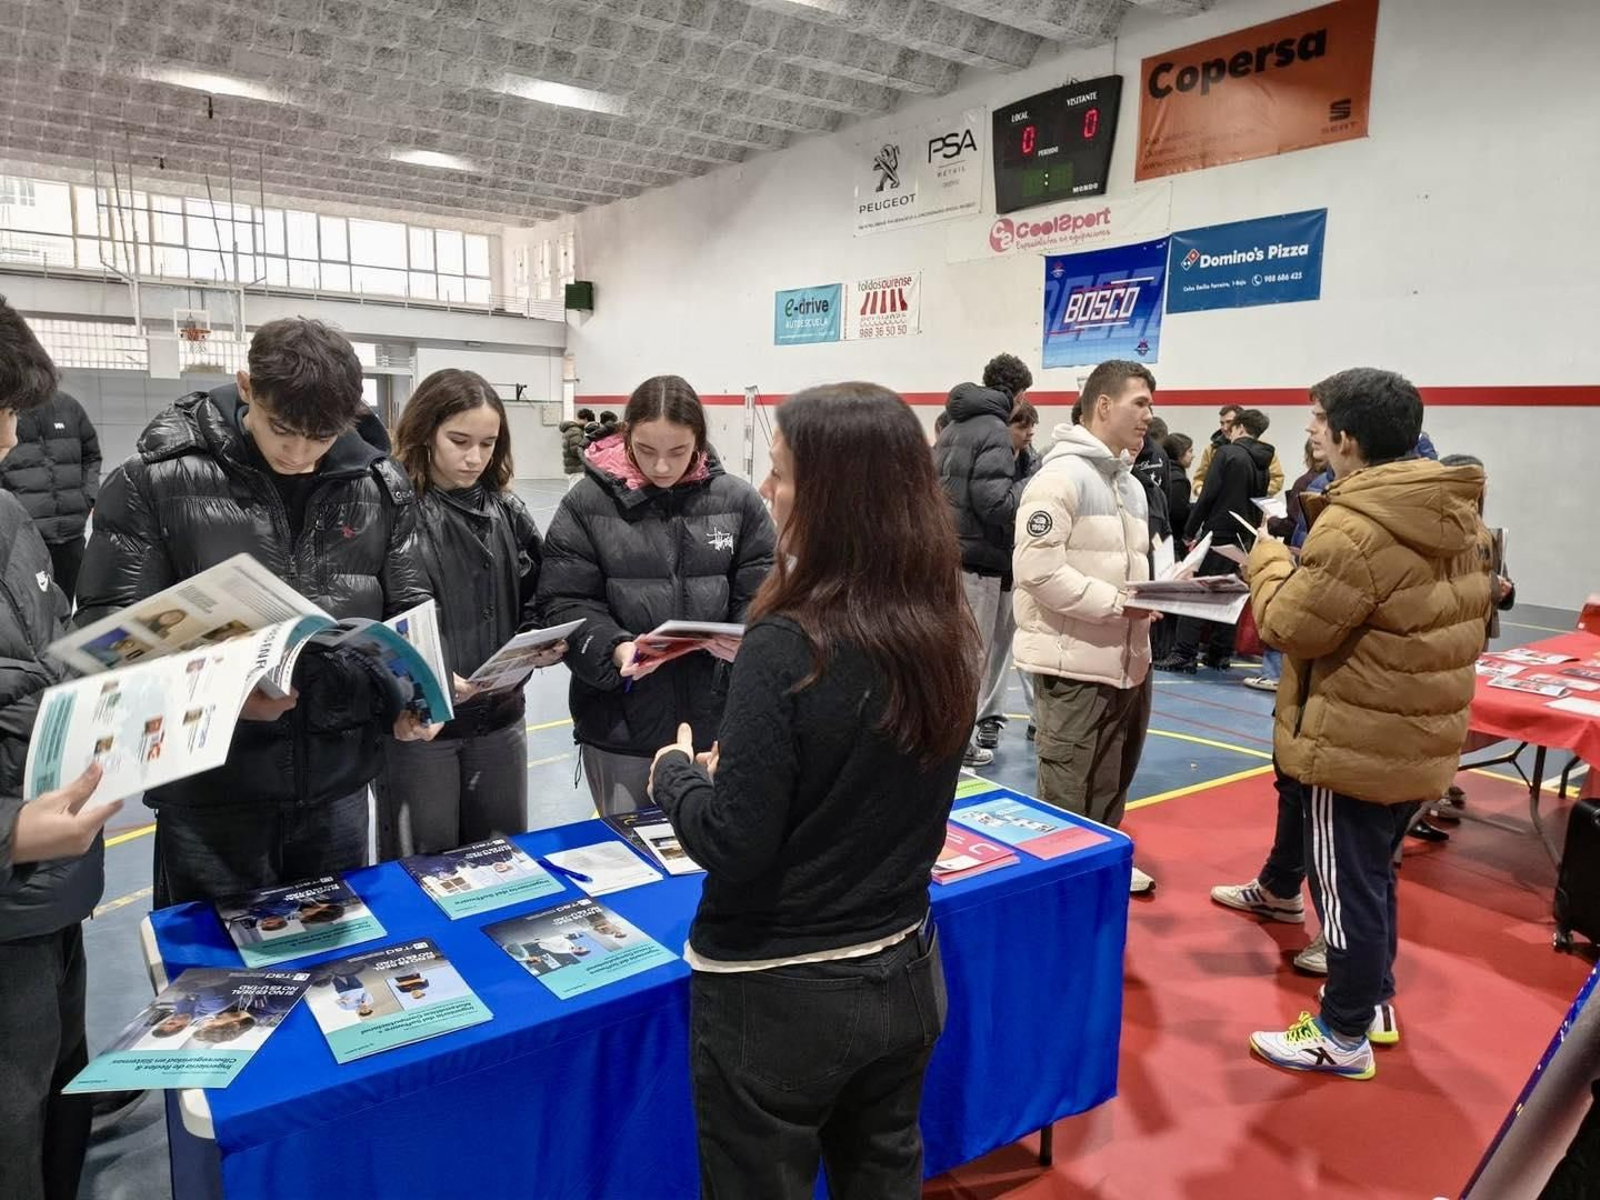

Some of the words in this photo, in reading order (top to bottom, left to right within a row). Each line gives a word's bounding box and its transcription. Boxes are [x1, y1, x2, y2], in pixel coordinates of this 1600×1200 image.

[1148, 28, 1328, 99] Copersa
[1066, 91, 1098, 107] VISITANTE
[1010, 111, 1029, 123] LOCAL
[1083, 107, 1099, 138] 0
[928, 129, 977, 164] PSA
[1021, 124, 1036, 154] 0
[1038, 146, 1059, 157] PERIODO
[1072, 182, 1099, 193] MONDO
[859, 193, 917, 214] PEUGEOT
[1199, 246, 1264, 269] Domino's
[1268, 243, 1310, 260] Pizza
[785, 297, 829, 318] e-drive
[1063, 287, 1141, 323] BOSCO
[785, 317, 828, 330] AUTOESCUELA
[859, 327, 873, 338] 988
[886, 325, 896, 336] 50
[897, 324, 908, 335] 50
